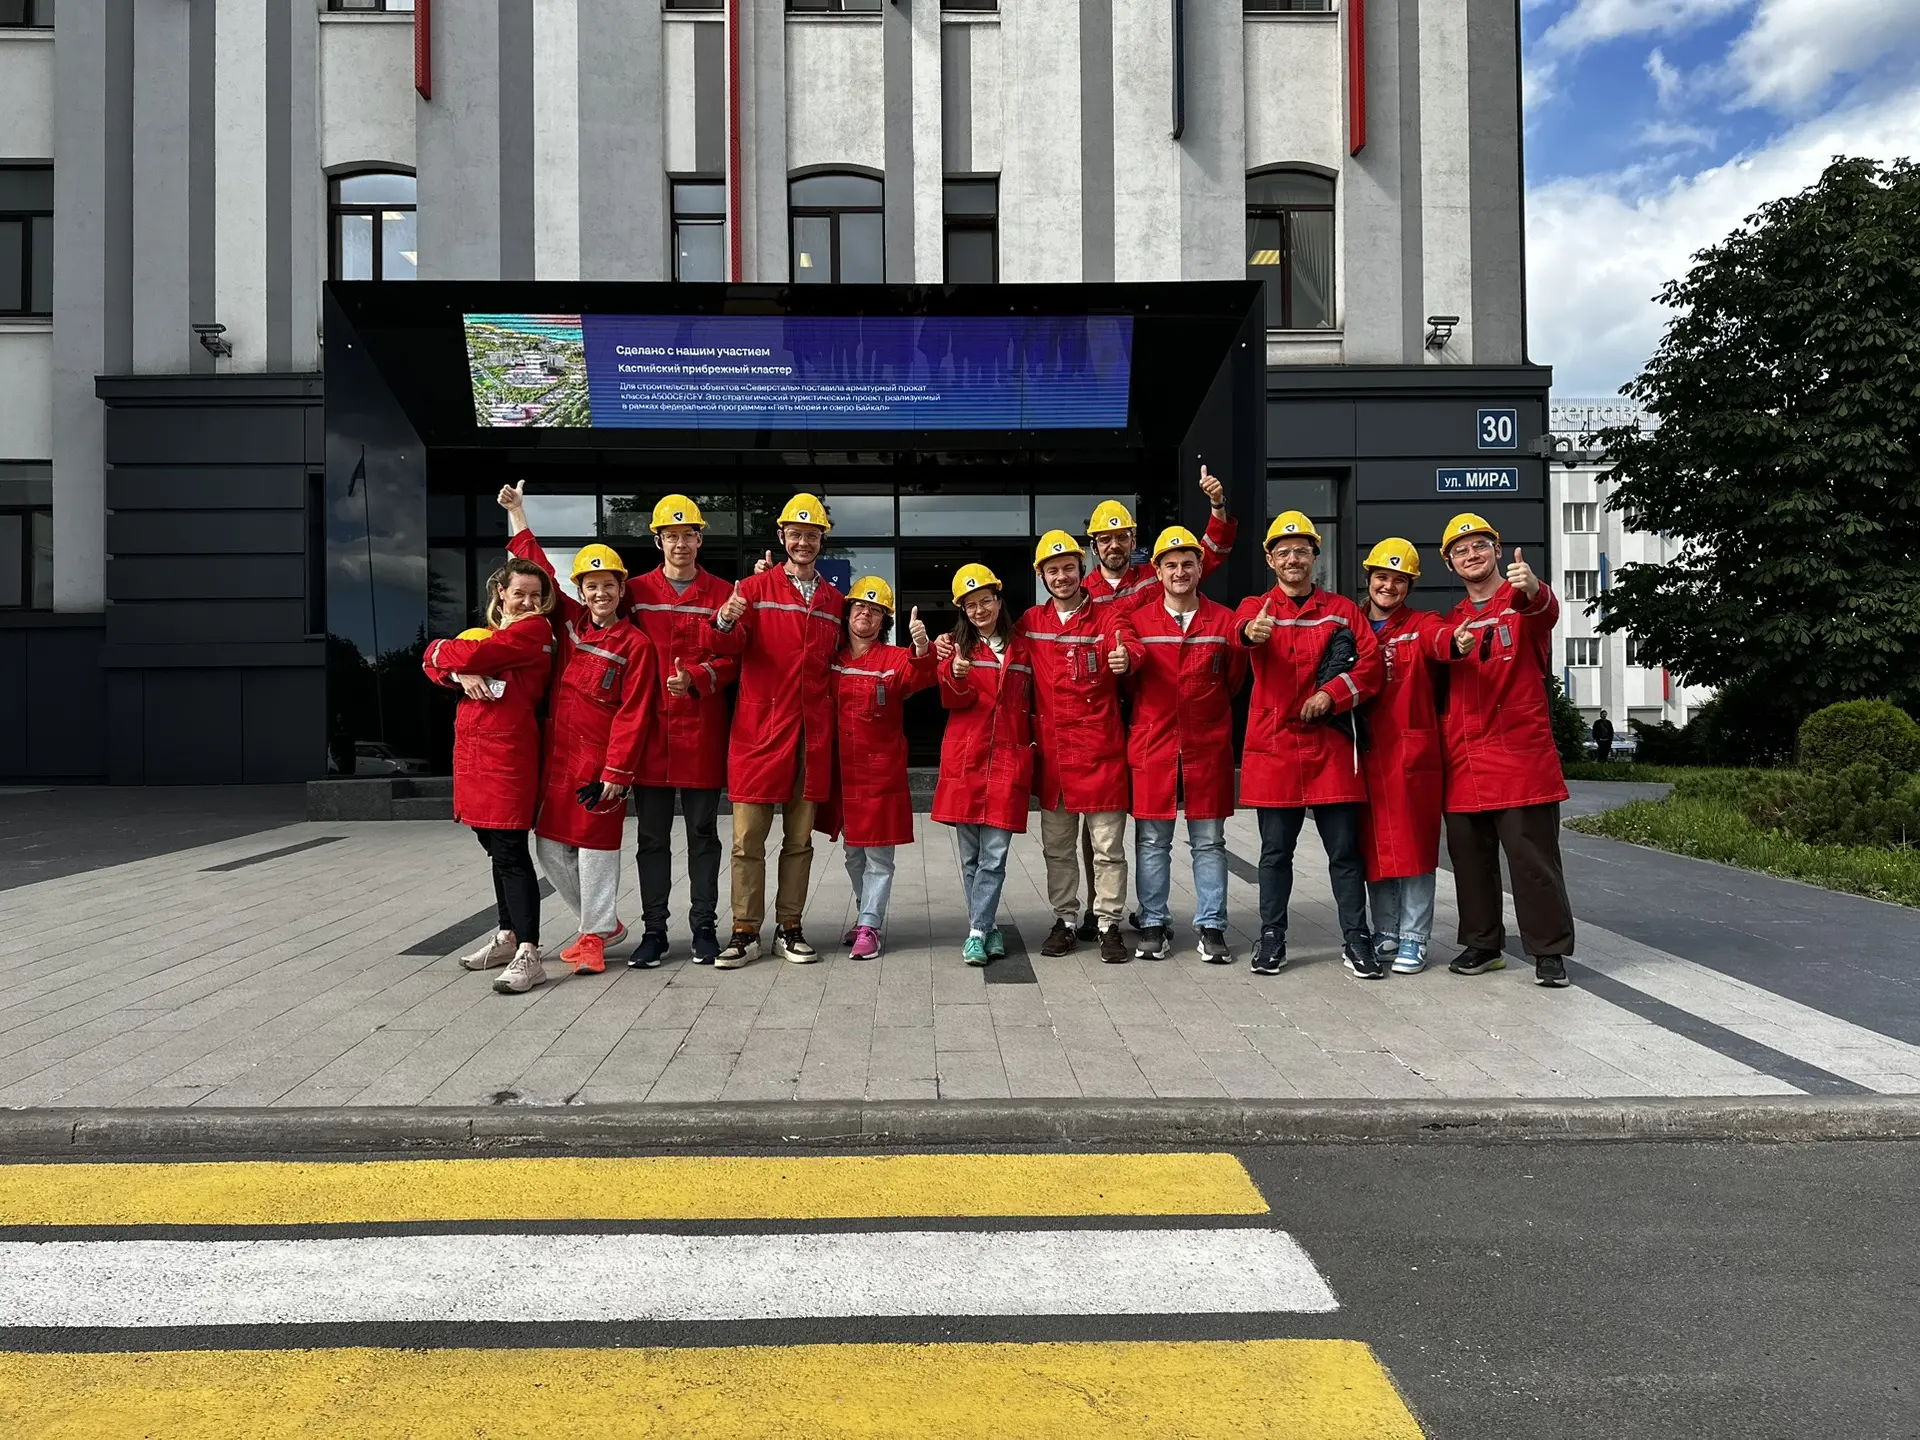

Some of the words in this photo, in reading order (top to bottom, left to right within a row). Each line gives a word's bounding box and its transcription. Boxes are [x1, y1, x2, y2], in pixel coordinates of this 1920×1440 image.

[616, 345, 665, 357] Сделано
[667, 348, 674, 356] с
[676, 347, 715, 356] нашим
[716, 347, 770, 358] участием
[618, 364, 681, 373] Каспийский
[682, 364, 749, 375] прибрежный
[751, 365, 792, 376] кластер
[620, 382, 636, 391] Для
[636, 383, 699, 392] строительства
[700, 382, 740, 391] объектов
[740, 383, 800, 393] «Северсталь»
[801, 384, 845, 392] поставила
[845, 383, 897, 393] арматурный
[898, 384, 927, 393] прокат
[621, 393, 650, 401] класса
[705, 393, 721, 401] Это
[722, 393, 788, 402] стратегический
[790, 394, 851, 403] туристический
[885, 393, 941, 403] реализуемый
[628, 403, 658, 411] рамках
[660, 402, 717, 412] федеральной
[718, 404, 767, 412] программы
[829, 404, 855, 412] озеро
[1482, 416, 1512, 442] 30
[1444, 477, 1462, 488] ул.
[1465, 472, 1511, 487] МИРА
